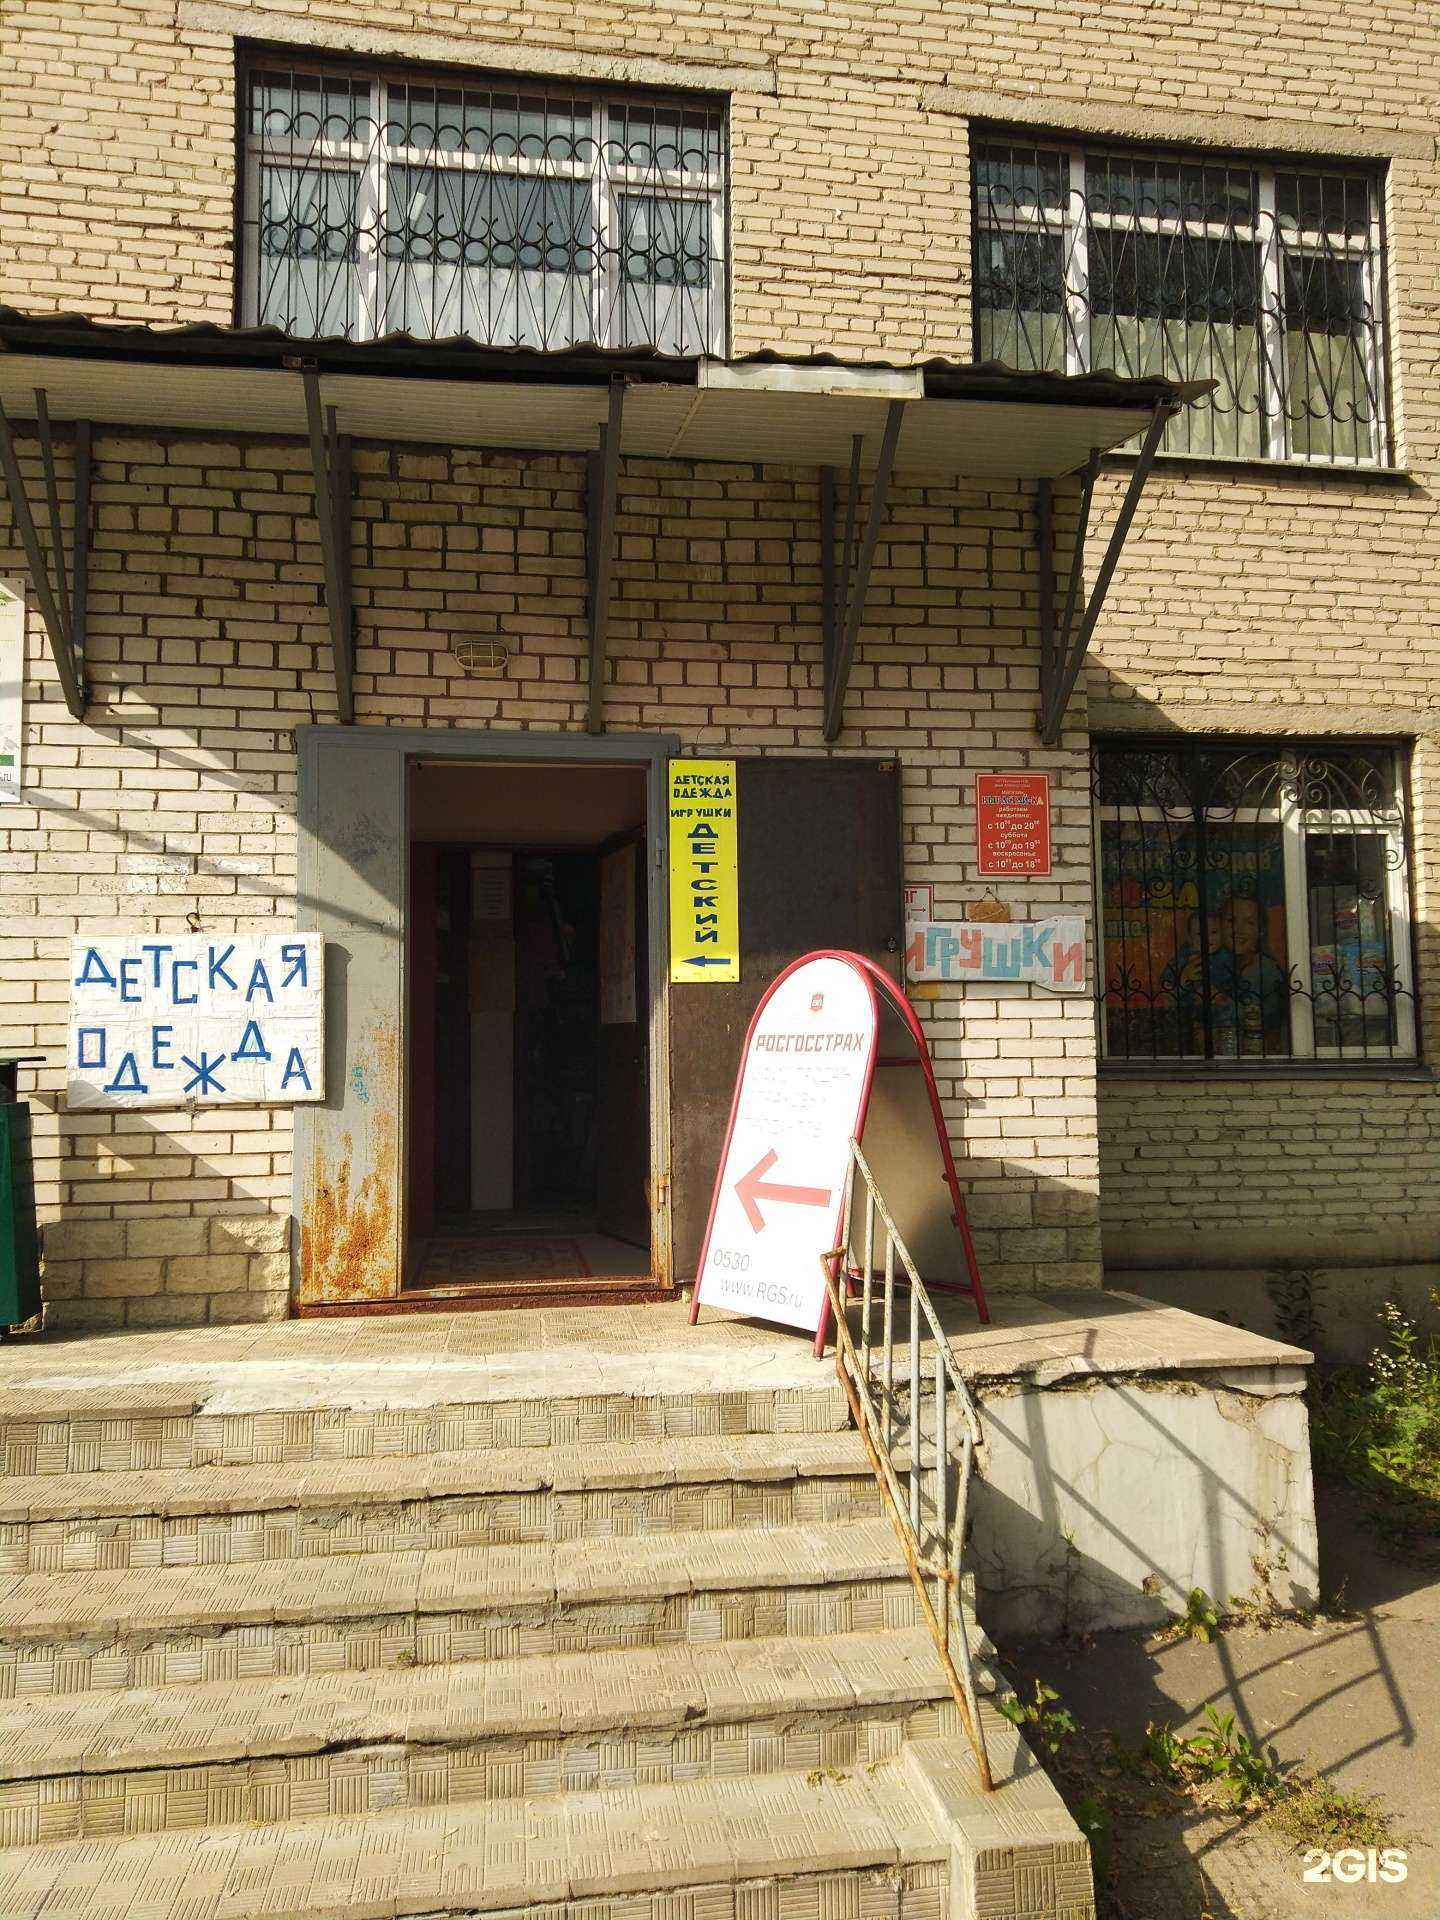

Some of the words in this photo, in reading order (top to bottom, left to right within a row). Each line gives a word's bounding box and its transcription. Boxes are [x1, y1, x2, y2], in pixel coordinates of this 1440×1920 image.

[673, 775, 730, 786] ДЕТСКАЯ
[673, 787, 733, 799] ОДЕЖДА
[670, 808, 732, 818] ИГРУШКИ
[1011, 823, 1023, 831] до
[1011, 862, 1024, 870] до
[687, 823, 719, 943] ДЕТСКИЙ
[906, 927, 1083, 982] ИГРУШКИ
[75, 944, 308, 1004] ДЕТСКАЯ
[755, 1032, 865, 1053] РОСГОССТРАХ
[78, 1020, 312, 1095] ОДЕЖДА
[713, 1248, 750, 1272] 0530
